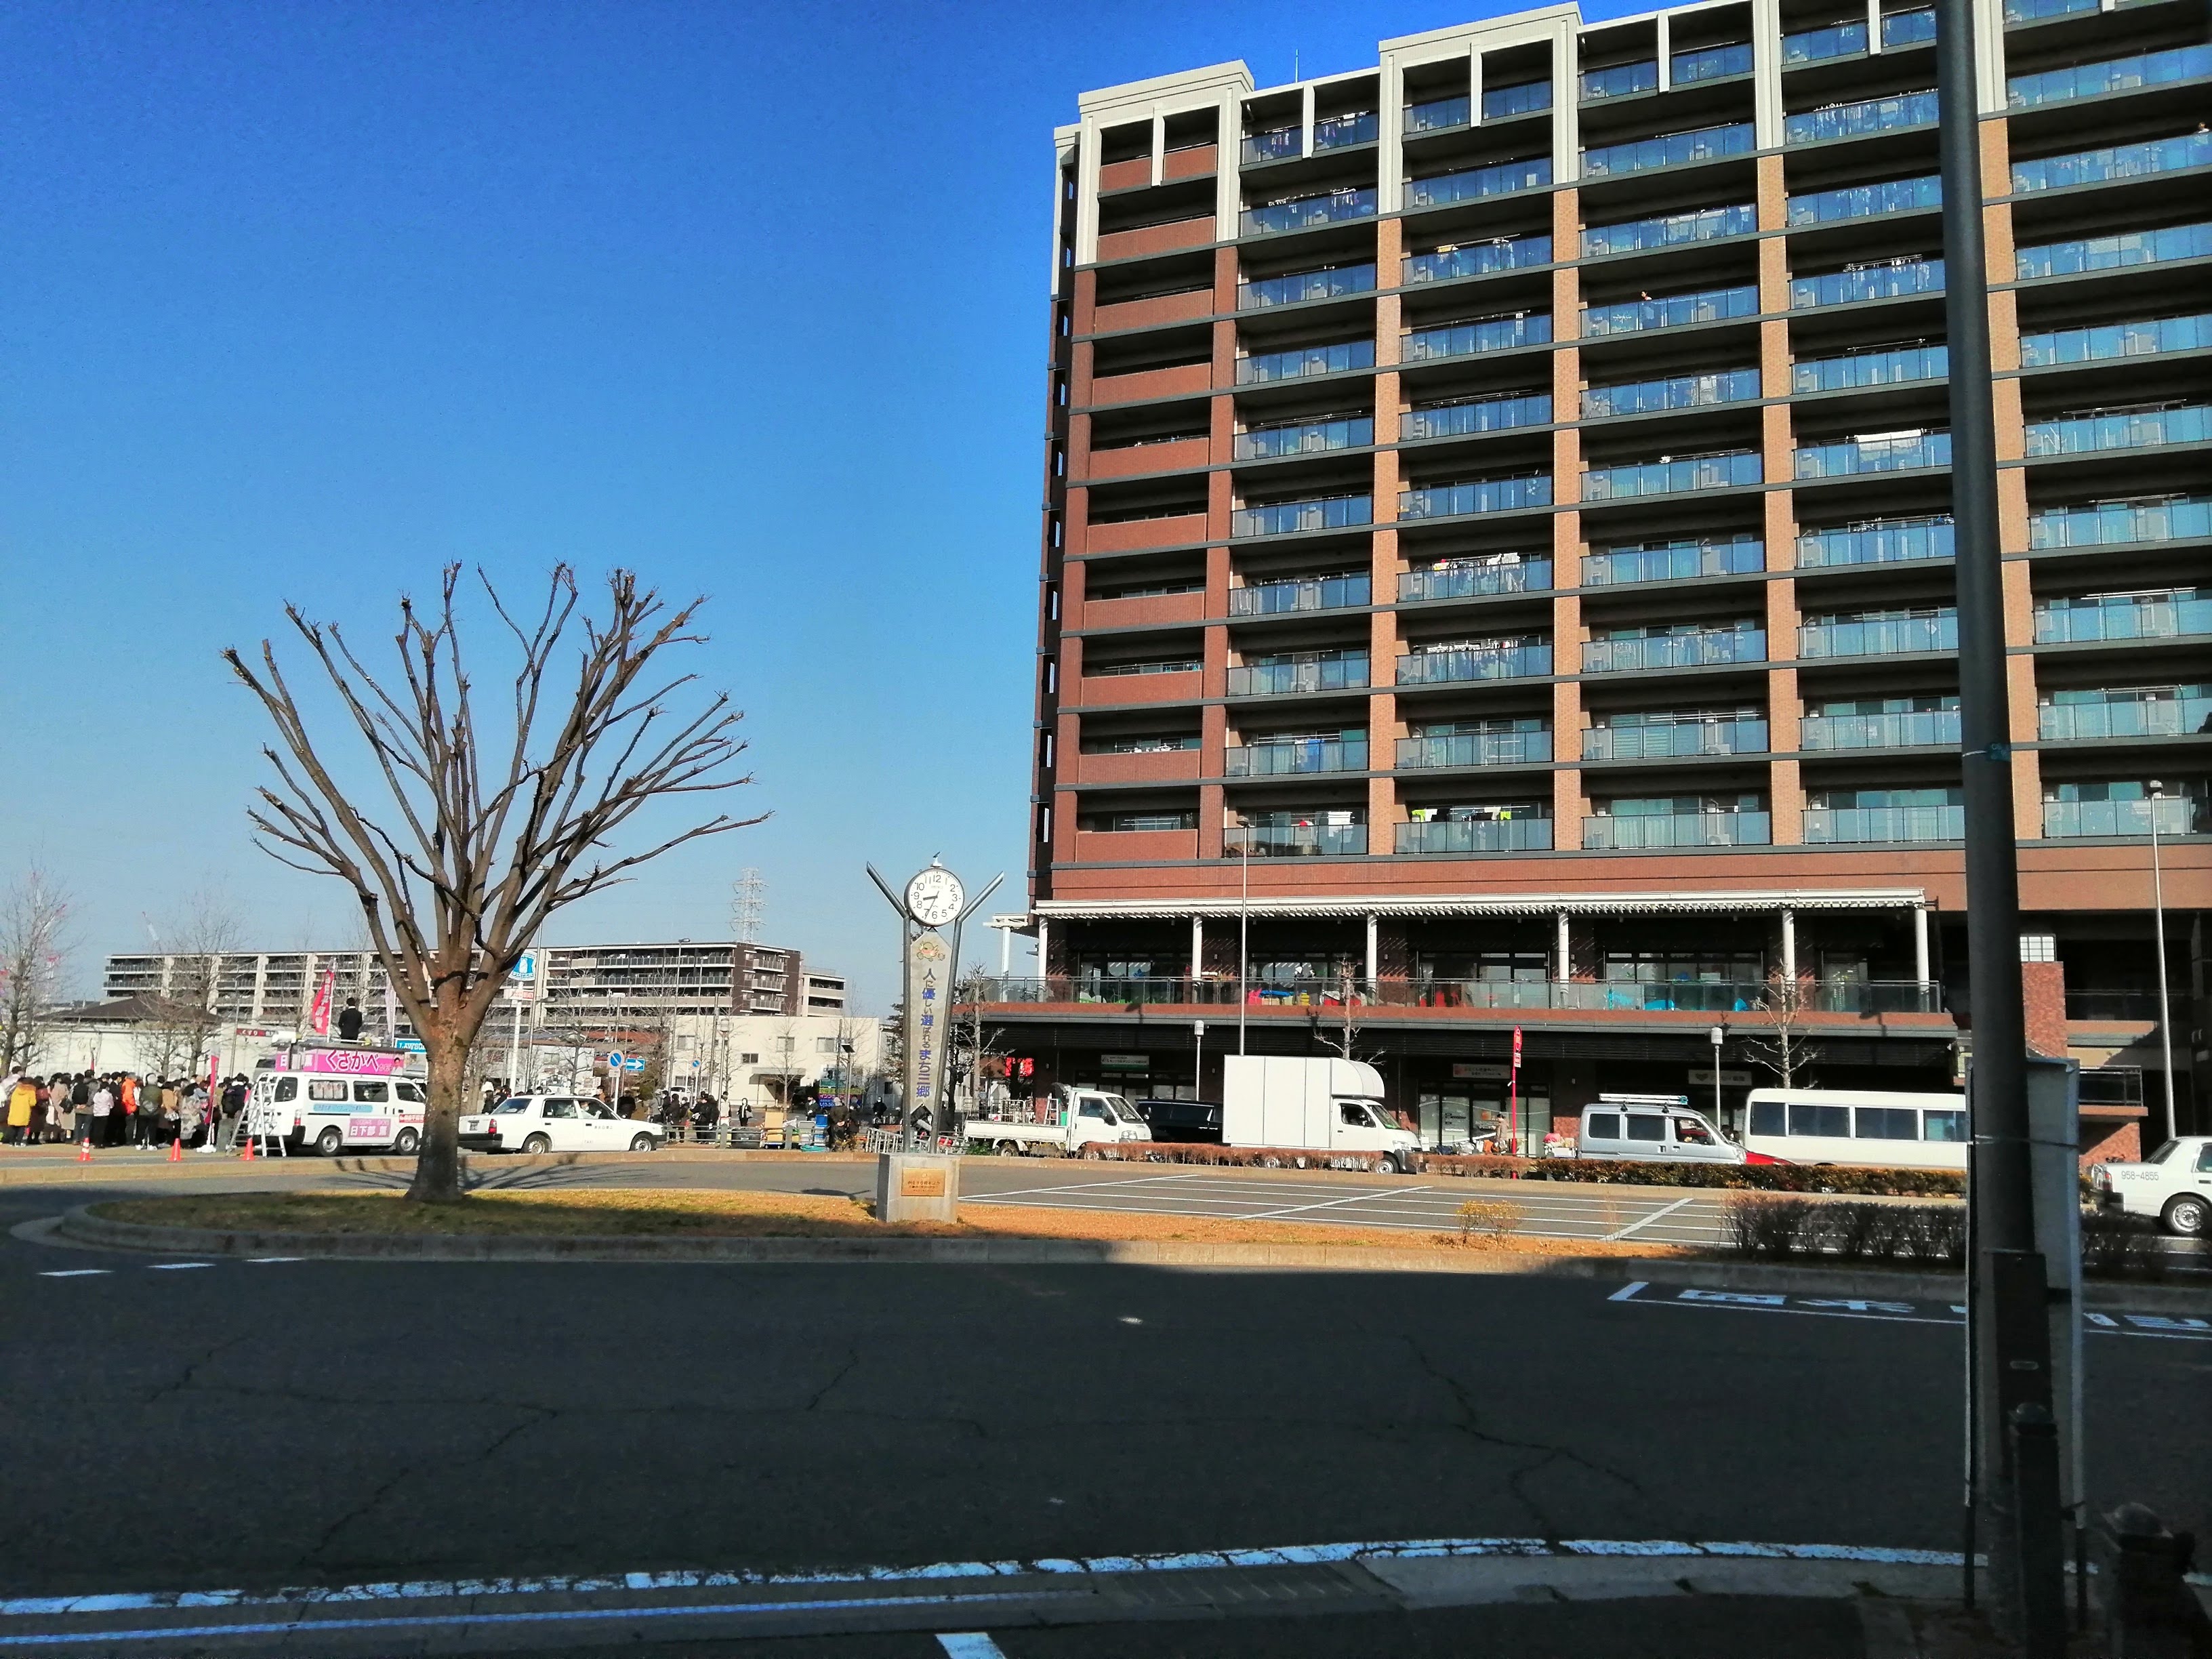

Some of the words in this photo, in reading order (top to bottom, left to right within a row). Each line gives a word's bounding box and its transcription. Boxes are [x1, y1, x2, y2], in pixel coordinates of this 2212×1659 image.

[916, 882, 924, 890] 10
[950, 884, 956, 892] 2
[916, 901, 922, 909] 8
[916, 968, 937, 1098] 人に優しい選ばれるまち三郷
[398, 1042, 426, 1050] LAWSO
[326, 1049, 380, 1072] くさかべ
[350, 1126, 376, 1136] 日下部
[2121, 1170, 2159, 1181] 958-4855
